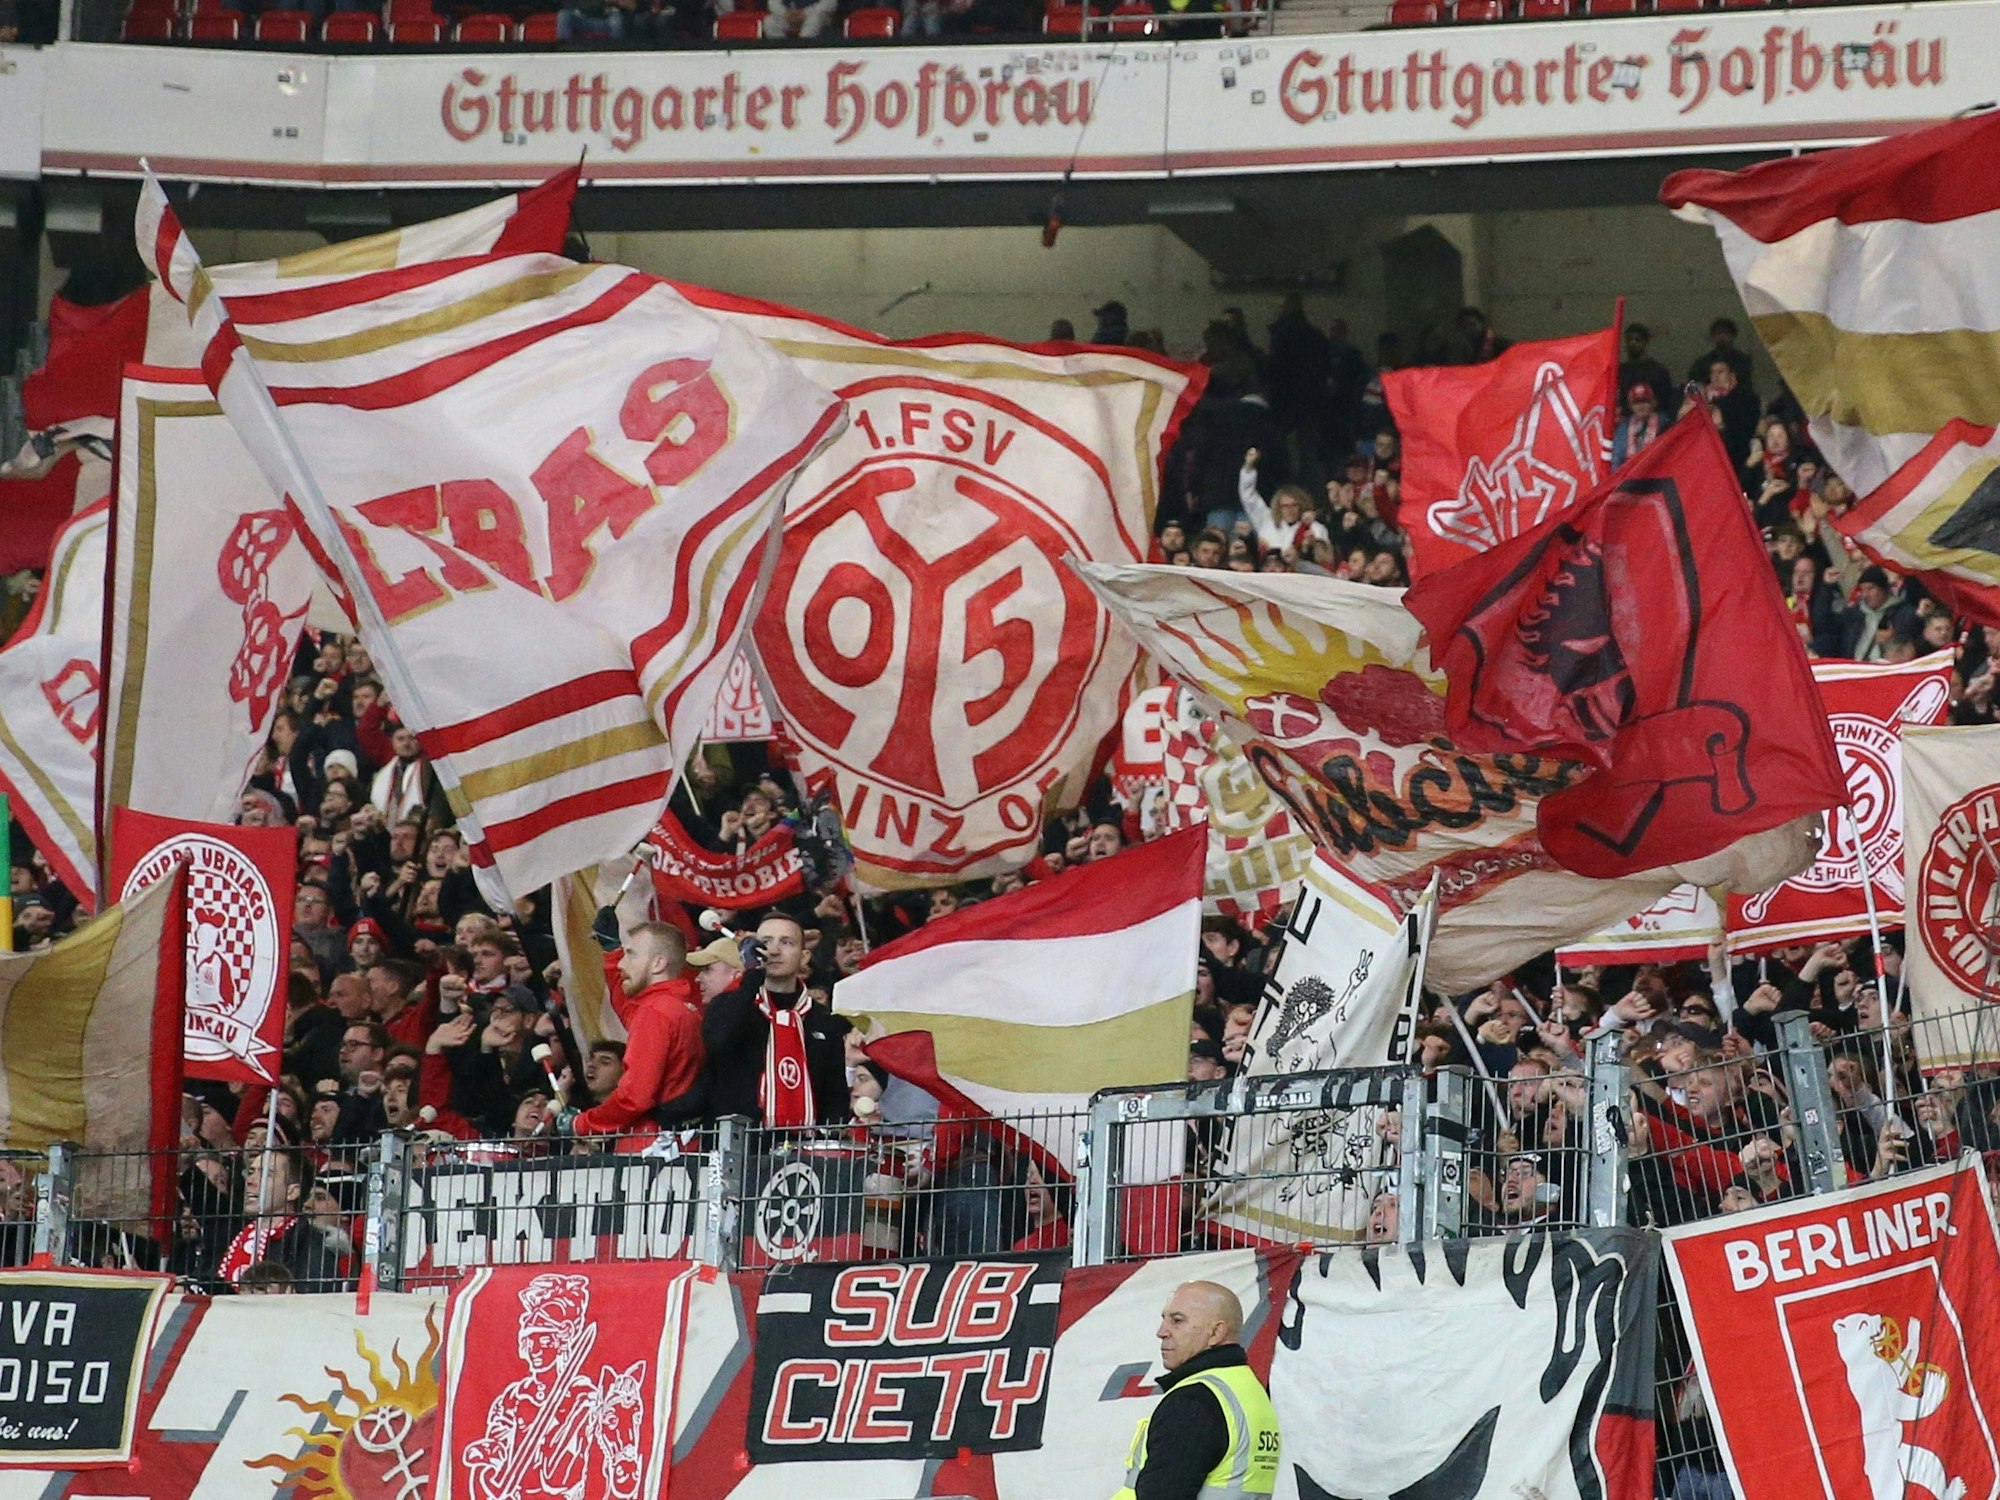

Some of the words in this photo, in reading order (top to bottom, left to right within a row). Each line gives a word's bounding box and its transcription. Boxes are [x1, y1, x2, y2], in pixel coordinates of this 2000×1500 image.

[441, 67, 820, 151] Stuttgarter
[1279, 43, 1649, 129] Stuttgarter
[1669, 22, 1946, 113] Hofbräu
[1834, 724, 1894, 753] ANNTE
[806, 765, 966, 858] AINZ
[202, 847, 265, 920] UBRIACO
[1724, 1191, 1958, 1292] BERLINER
[824, 1261, 1039, 1347] SUB
[27, 1418, 79, 1441] uns!
[762, 1347, 1051, 1444] CIETY
[1258, 1430, 1279, 1451] SDS
